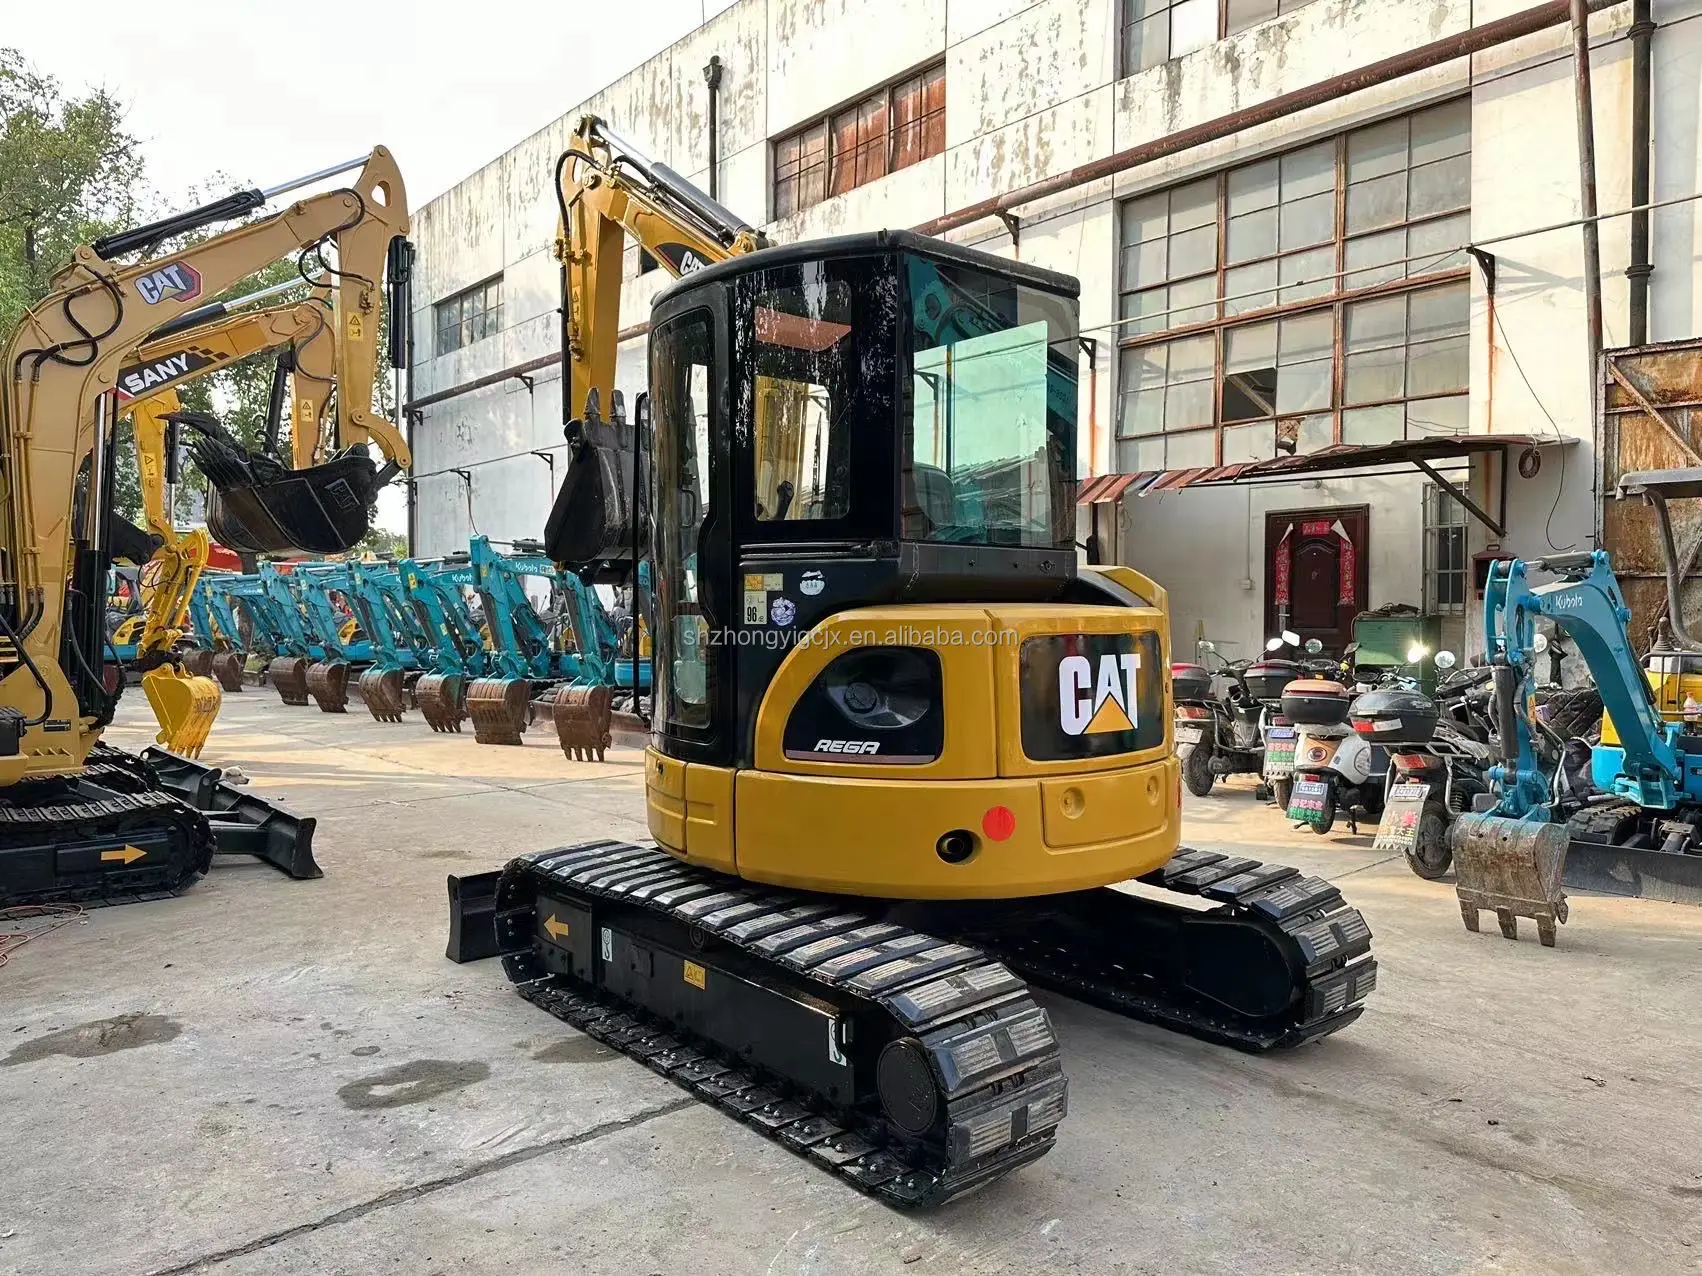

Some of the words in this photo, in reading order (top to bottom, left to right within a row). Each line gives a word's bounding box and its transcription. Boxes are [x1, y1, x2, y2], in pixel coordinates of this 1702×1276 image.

[135, 265, 187, 304] CAT
[125, 353, 189, 393] SANY
[747, 606, 757, 622] 96
[1555, 593, 1583, 609] Kubota
[1058, 653, 1141, 736] CAT
[813, 739, 881, 755] REGA
